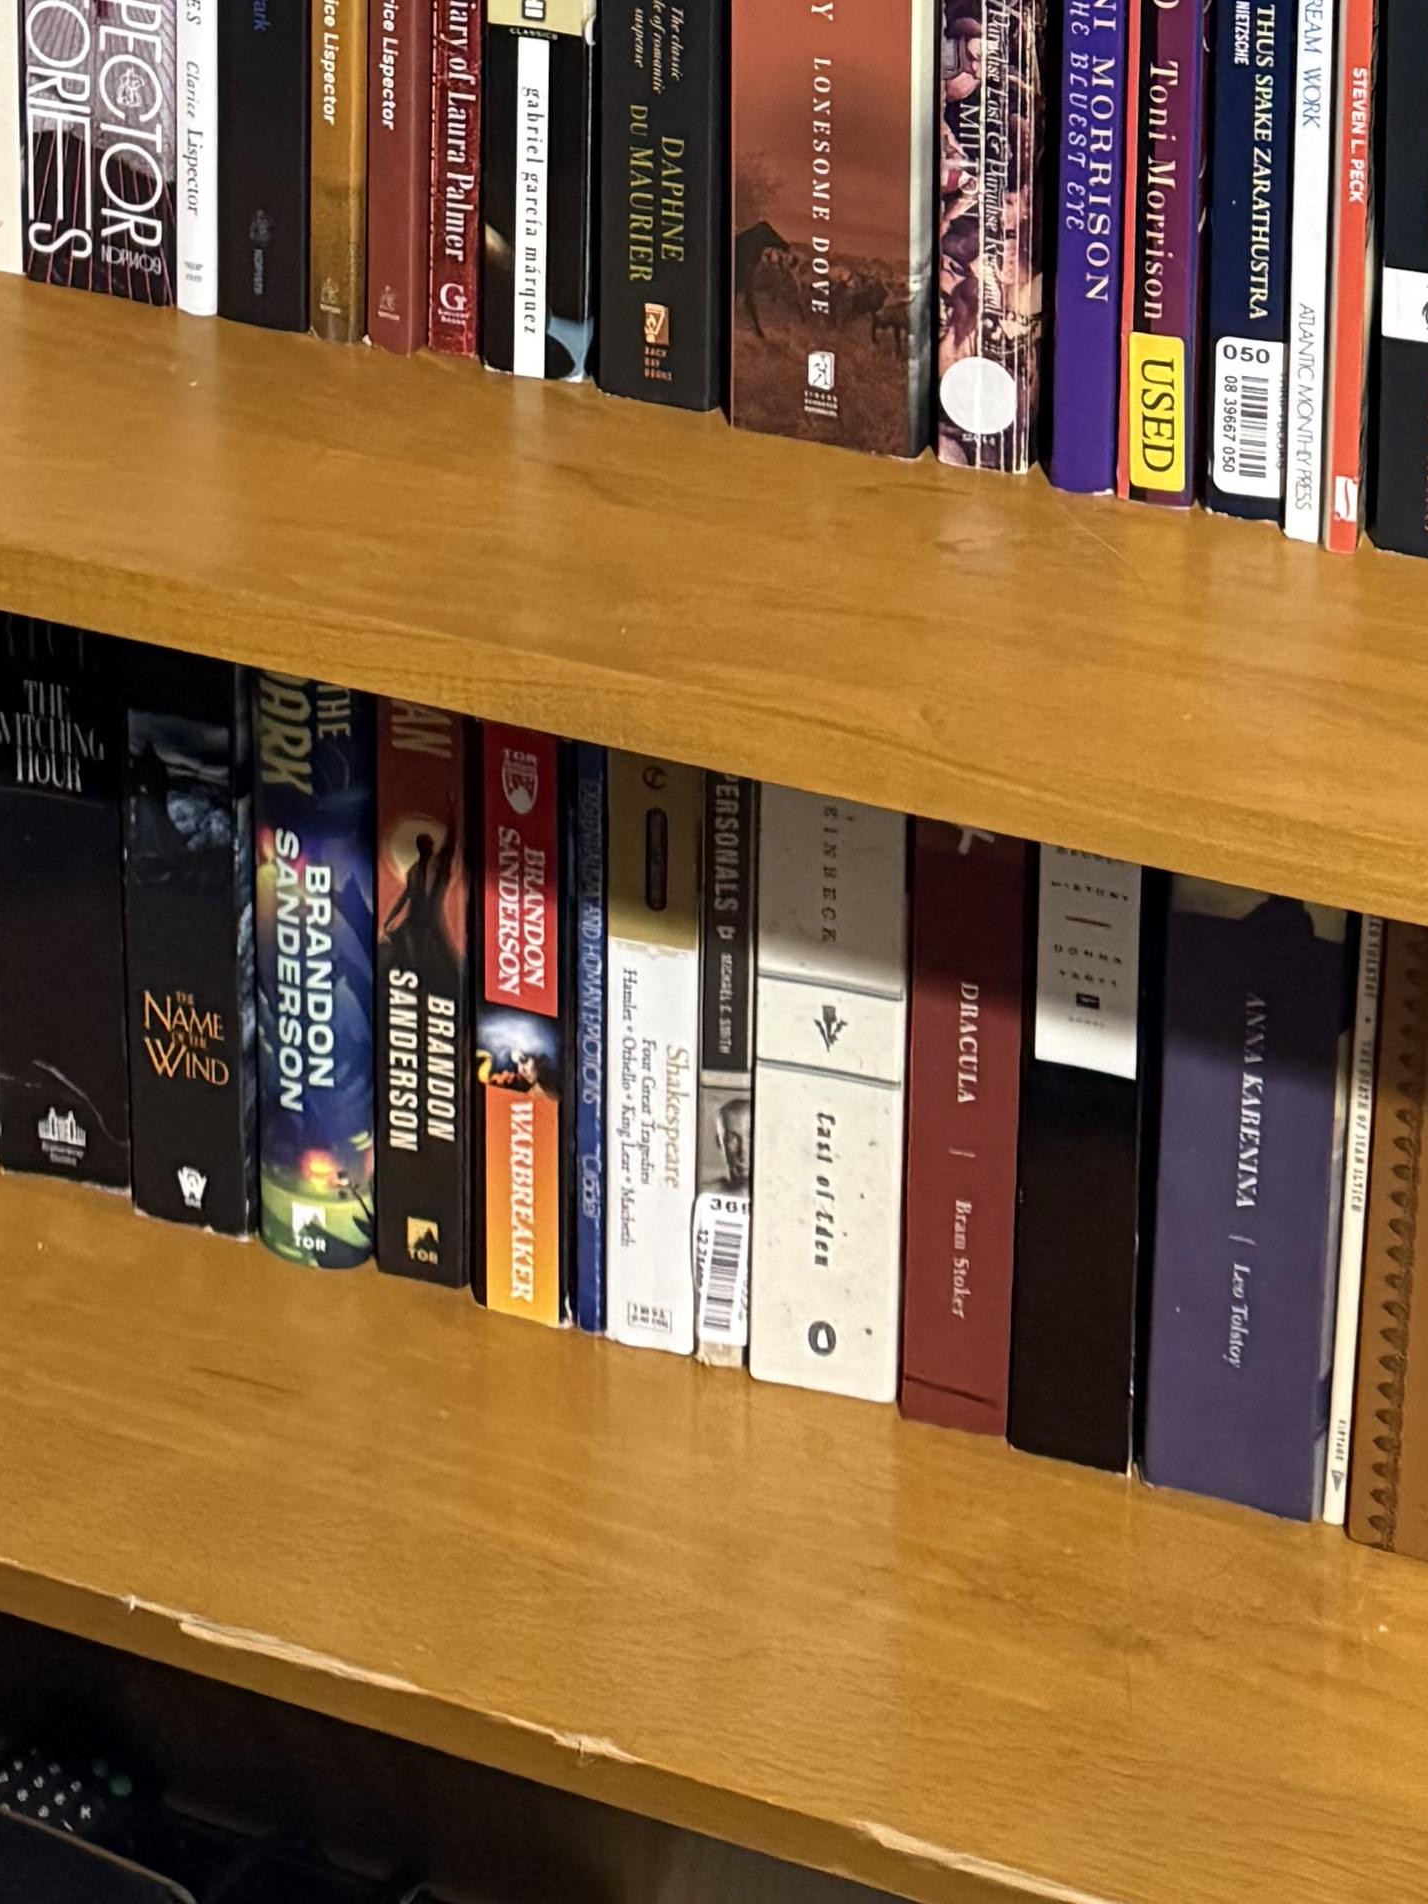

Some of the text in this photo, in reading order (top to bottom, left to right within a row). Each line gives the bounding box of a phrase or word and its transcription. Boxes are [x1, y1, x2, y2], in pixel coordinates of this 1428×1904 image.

[518, 86, 546, 335] gabriel garcía márquez
[629, 103, 655, 282] DU MAURIER
[660, 135, 686, 263] DAPHNE
[810, 56, 833, 315] LONESOME DOVE
[1083, 55, 1117, 303] MORRISON
[1140, 357, 1176, 474] USED
[1223, 343, 1270, 365] 050
[143, 990, 227, 1042] NAME
[143, 1037, 231, 1086] WIND
[274, 826, 305, 1113] SANDERSON
[304, 863, 335, 1091] BRANDON
[509, 1099, 536, 1303] WARBREAKER
[951, 981, 980, 1320] DRACULA Bram Stoker
